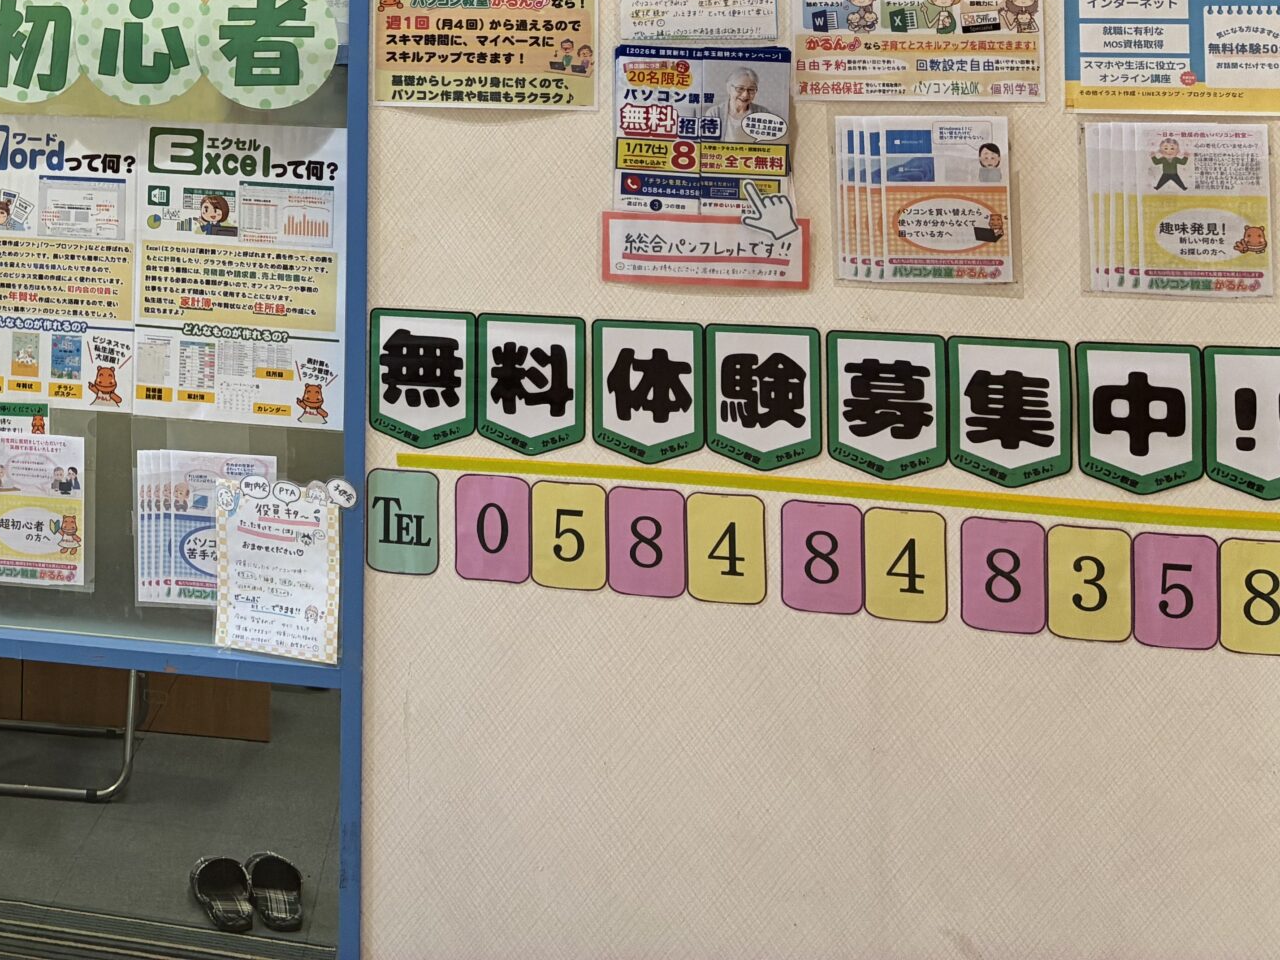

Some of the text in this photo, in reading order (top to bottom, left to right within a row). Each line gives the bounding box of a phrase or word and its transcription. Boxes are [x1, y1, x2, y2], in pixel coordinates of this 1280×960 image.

[1102, 25, 1164, 37] 就職に有利な
[1102, 38, 1164, 50] MOS資格取得
[385, 50, 525, 64] スキルアップできます!
[796, 58, 847, 72] 自由予約
[916, 58, 995, 72] 回数設定自由
[1084, 60, 1187, 72] スマホや生活に役立つ
[628, 70, 690, 86] 20名限定
[1098, 73, 1172, 85] オンライン講座
[624, 88, 715, 104] パソコン講習
[799, 81, 865, 95] 資格合格保証
[913, 81, 980, 96] パソコン持込OK
[990, 83, 1040, 96] 個別学習
[11, 131, 58, 146] ワード
[207, 137, 262, 152] エクセル
[625, 142, 669, 156] 1/17(土)
[671, 141, 784, 171] 8 全て無料
[623, 158, 667, 167] までの申し込みで
[897, 230, 953, 238] 困っている方へ
[1159, 221, 1227, 236] 趣味発見!
[623, 232, 792, 258] 総合パンフレットです!!
[1179, 237, 1225, 245] 新しい何かを
[1179, 248, 1226, 256] お探しの方へ
[182, 323, 289, 342] どんなものが作れるの?
[92, 336, 131, 351] ビジネスでも
[379, 328, 1280, 457] 無料体験募集中!
[373, 416, 420, 442] パソコン教室
[480, 423, 529, 451] パソコン教室
[597, 431, 646, 458] パソコン教室
[711, 438, 761, 465] パソコン教室
[832, 445, 885, 474] パソコン教室
[953, 452, 1008, 482] パソコン教室
[1084, 460, 1139, 489] パソコン教室
[1210, 466, 1266, 493] パソコン教室
[371, 496, 432, 548] TEL
[25, 533, 52, 542] の方へ
[476, 501, 746, 578] 0584
